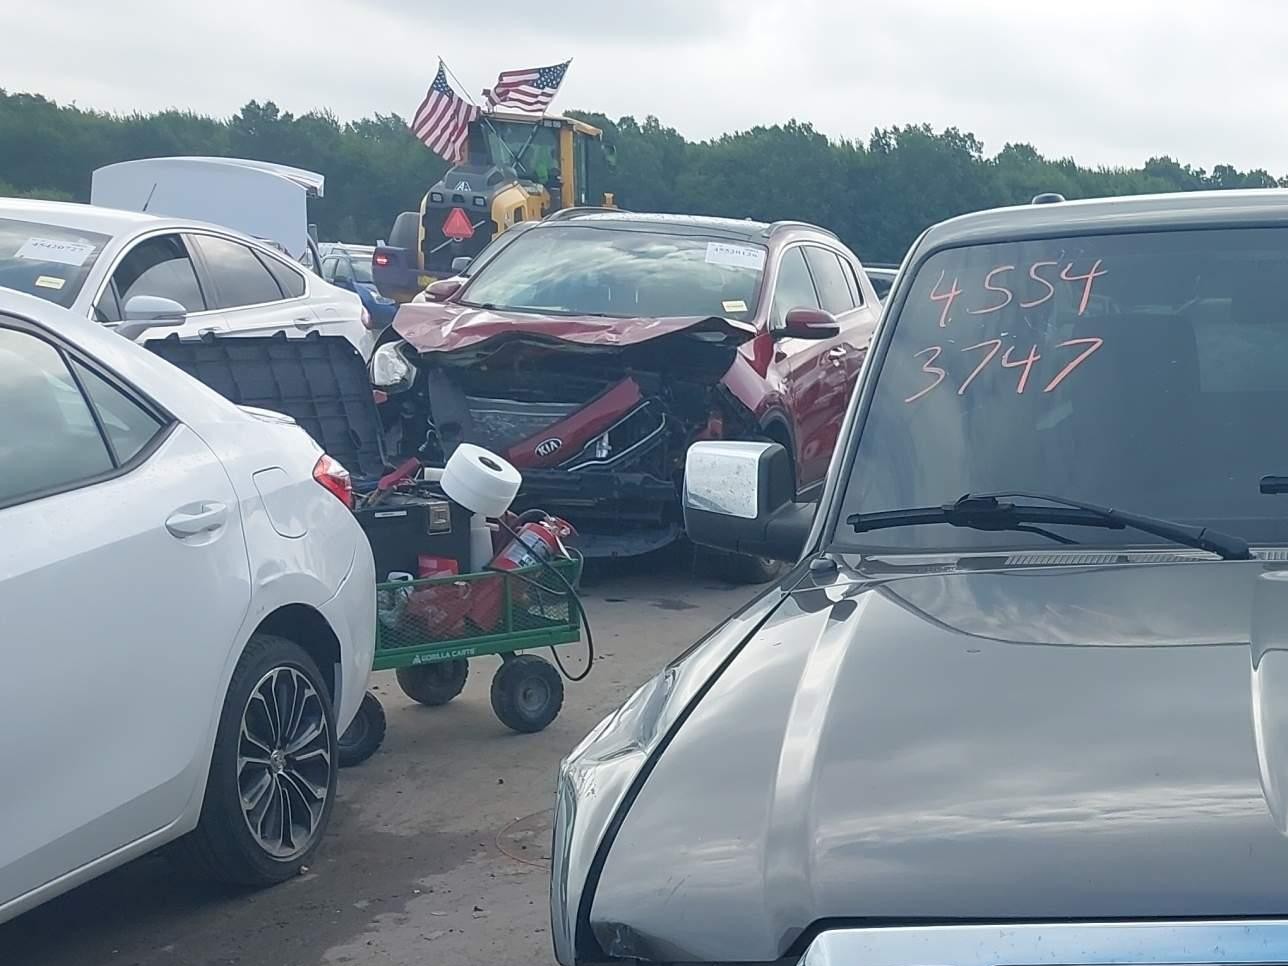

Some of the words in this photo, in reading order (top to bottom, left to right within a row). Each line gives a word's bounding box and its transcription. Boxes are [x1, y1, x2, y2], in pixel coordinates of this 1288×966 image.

[929, 258, 1108, 328] 4554
[905, 337, 1104, 403] 3747
[537, 442, 559, 457] KIA
